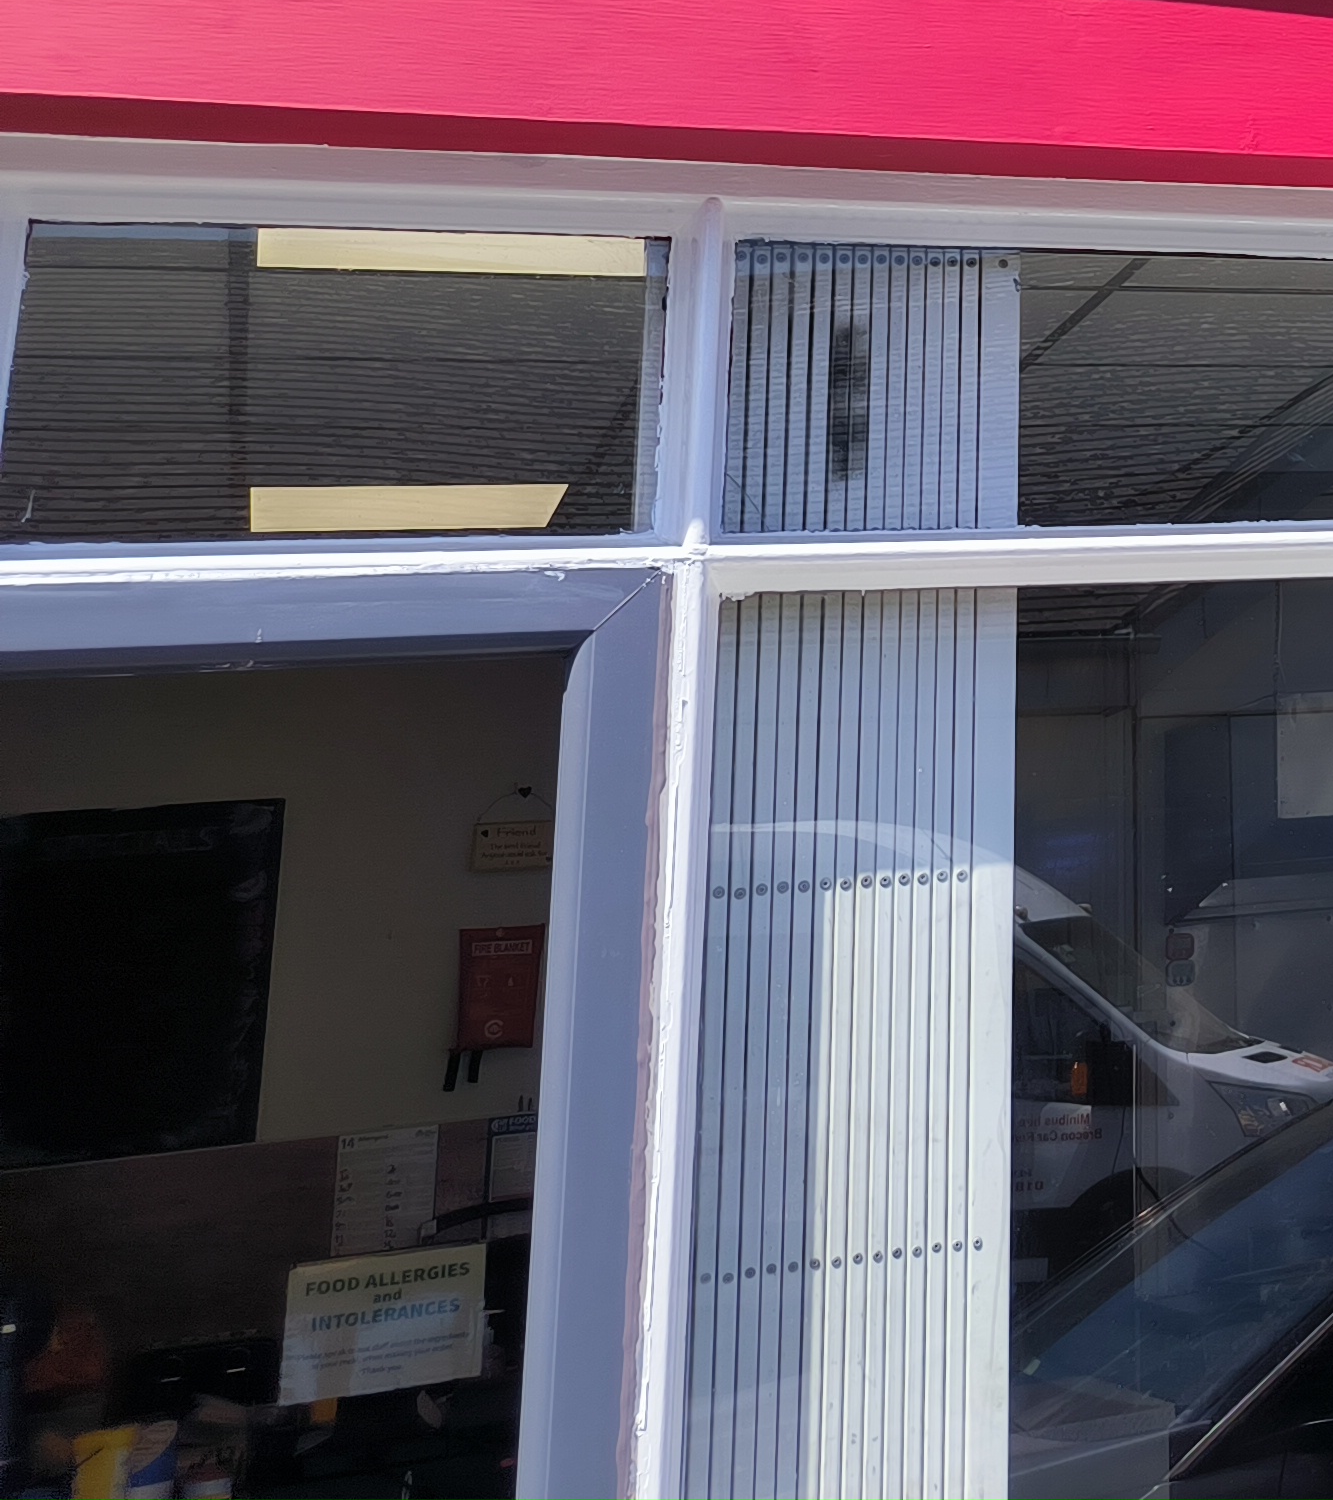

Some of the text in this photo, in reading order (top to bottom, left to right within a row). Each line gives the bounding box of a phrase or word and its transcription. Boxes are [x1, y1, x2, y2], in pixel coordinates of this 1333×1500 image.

[474, 941, 531, 954] FIRE BLANKET
[306, 1262, 471, 1297] FOOD ALLERGIES
[373, 1289, 403, 1305] and
[311, 1297, 462, 1333] INTOLERANCES
